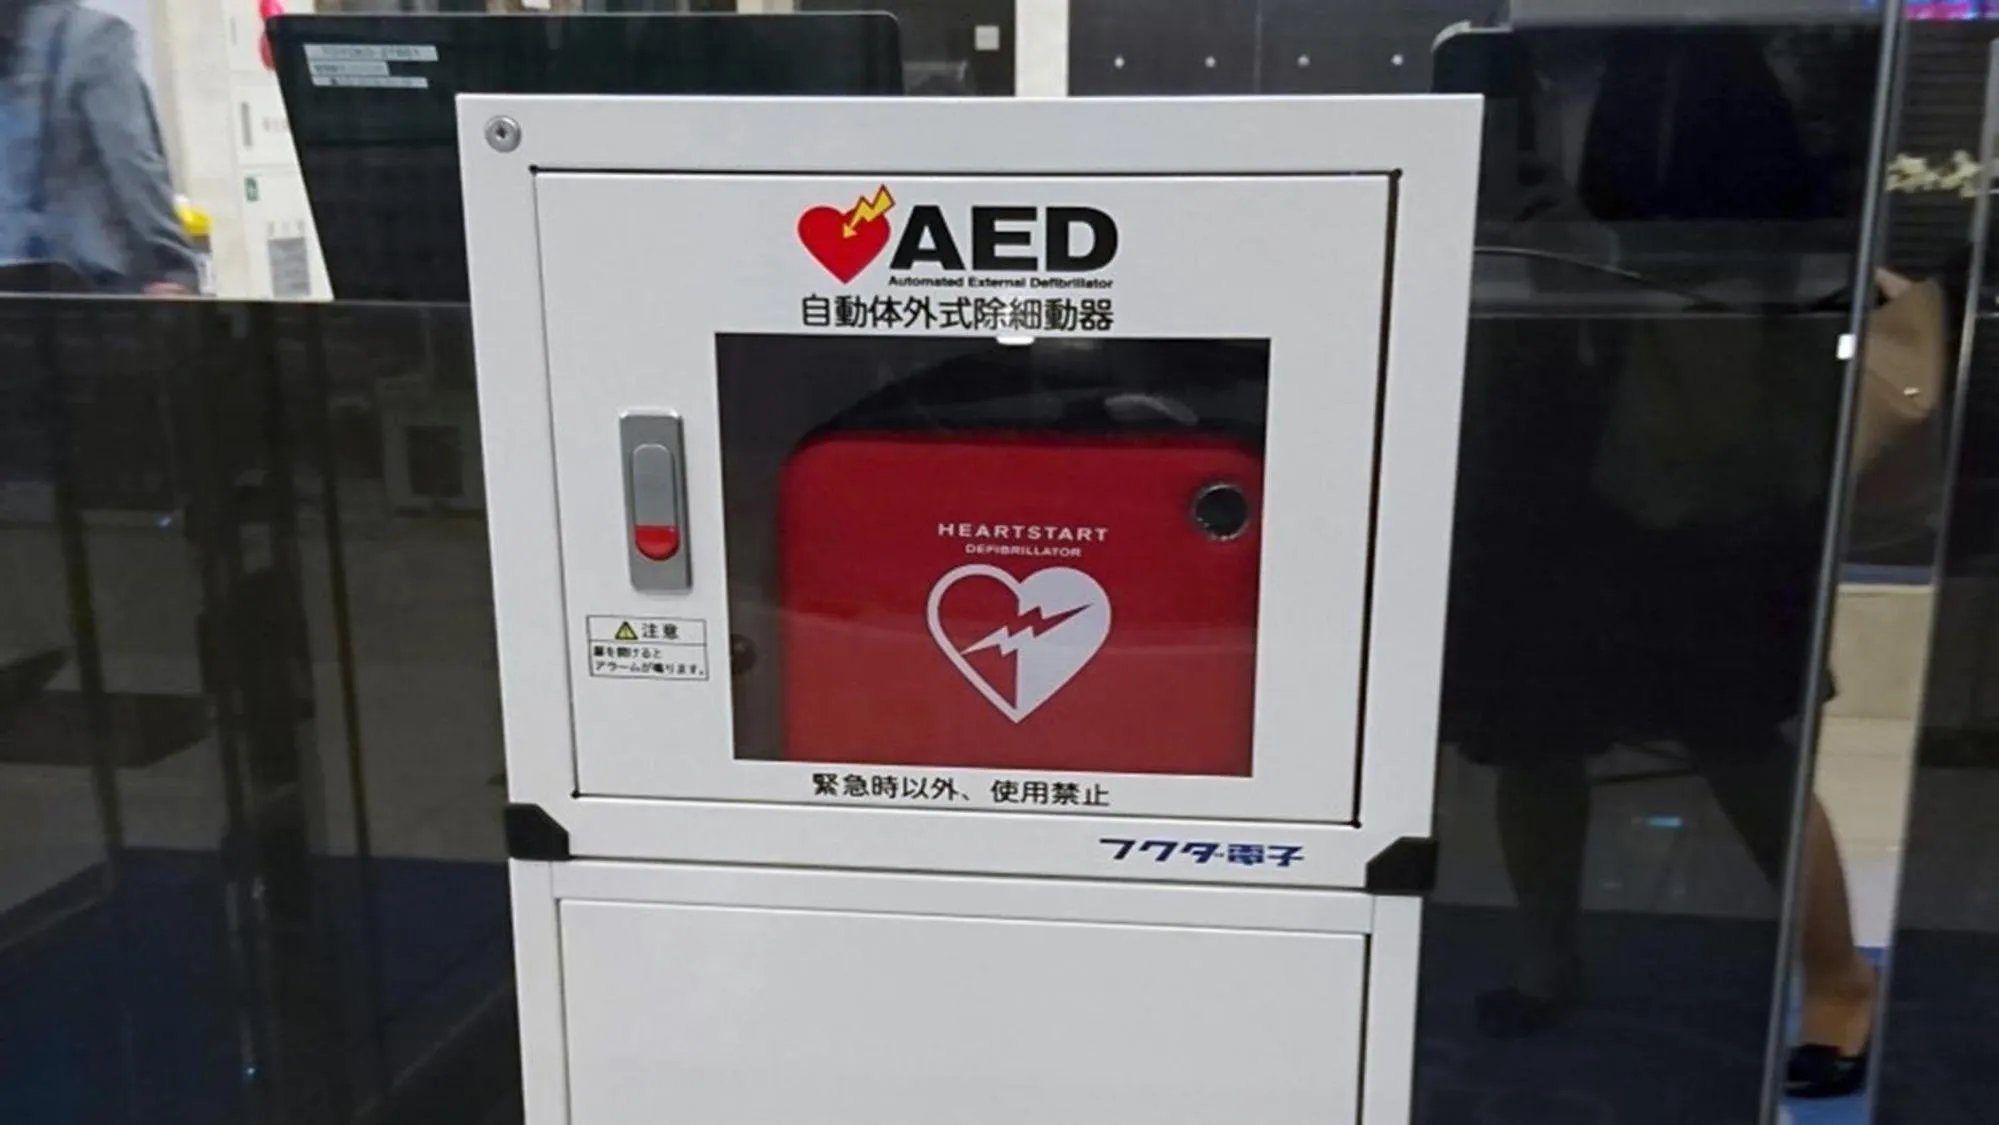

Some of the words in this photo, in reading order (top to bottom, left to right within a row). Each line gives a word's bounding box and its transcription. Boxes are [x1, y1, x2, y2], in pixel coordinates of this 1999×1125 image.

[889, 204, 1119, 273] AED
[888, 276, 964, 288] Automated
[967, 277, 1026, 289] External
[1029, 277, 1114, 290] Defibrillator
[802, 293, 1114, 331] 自動体外式除細動器
[937, 523, 1108, 541] HEARTSTART
[965, 543, 1082, 557] DEFIBRILLATOR
[641, 623, 679, 640] 注意
[1099, 838, 1304, 867] フクダ電子
